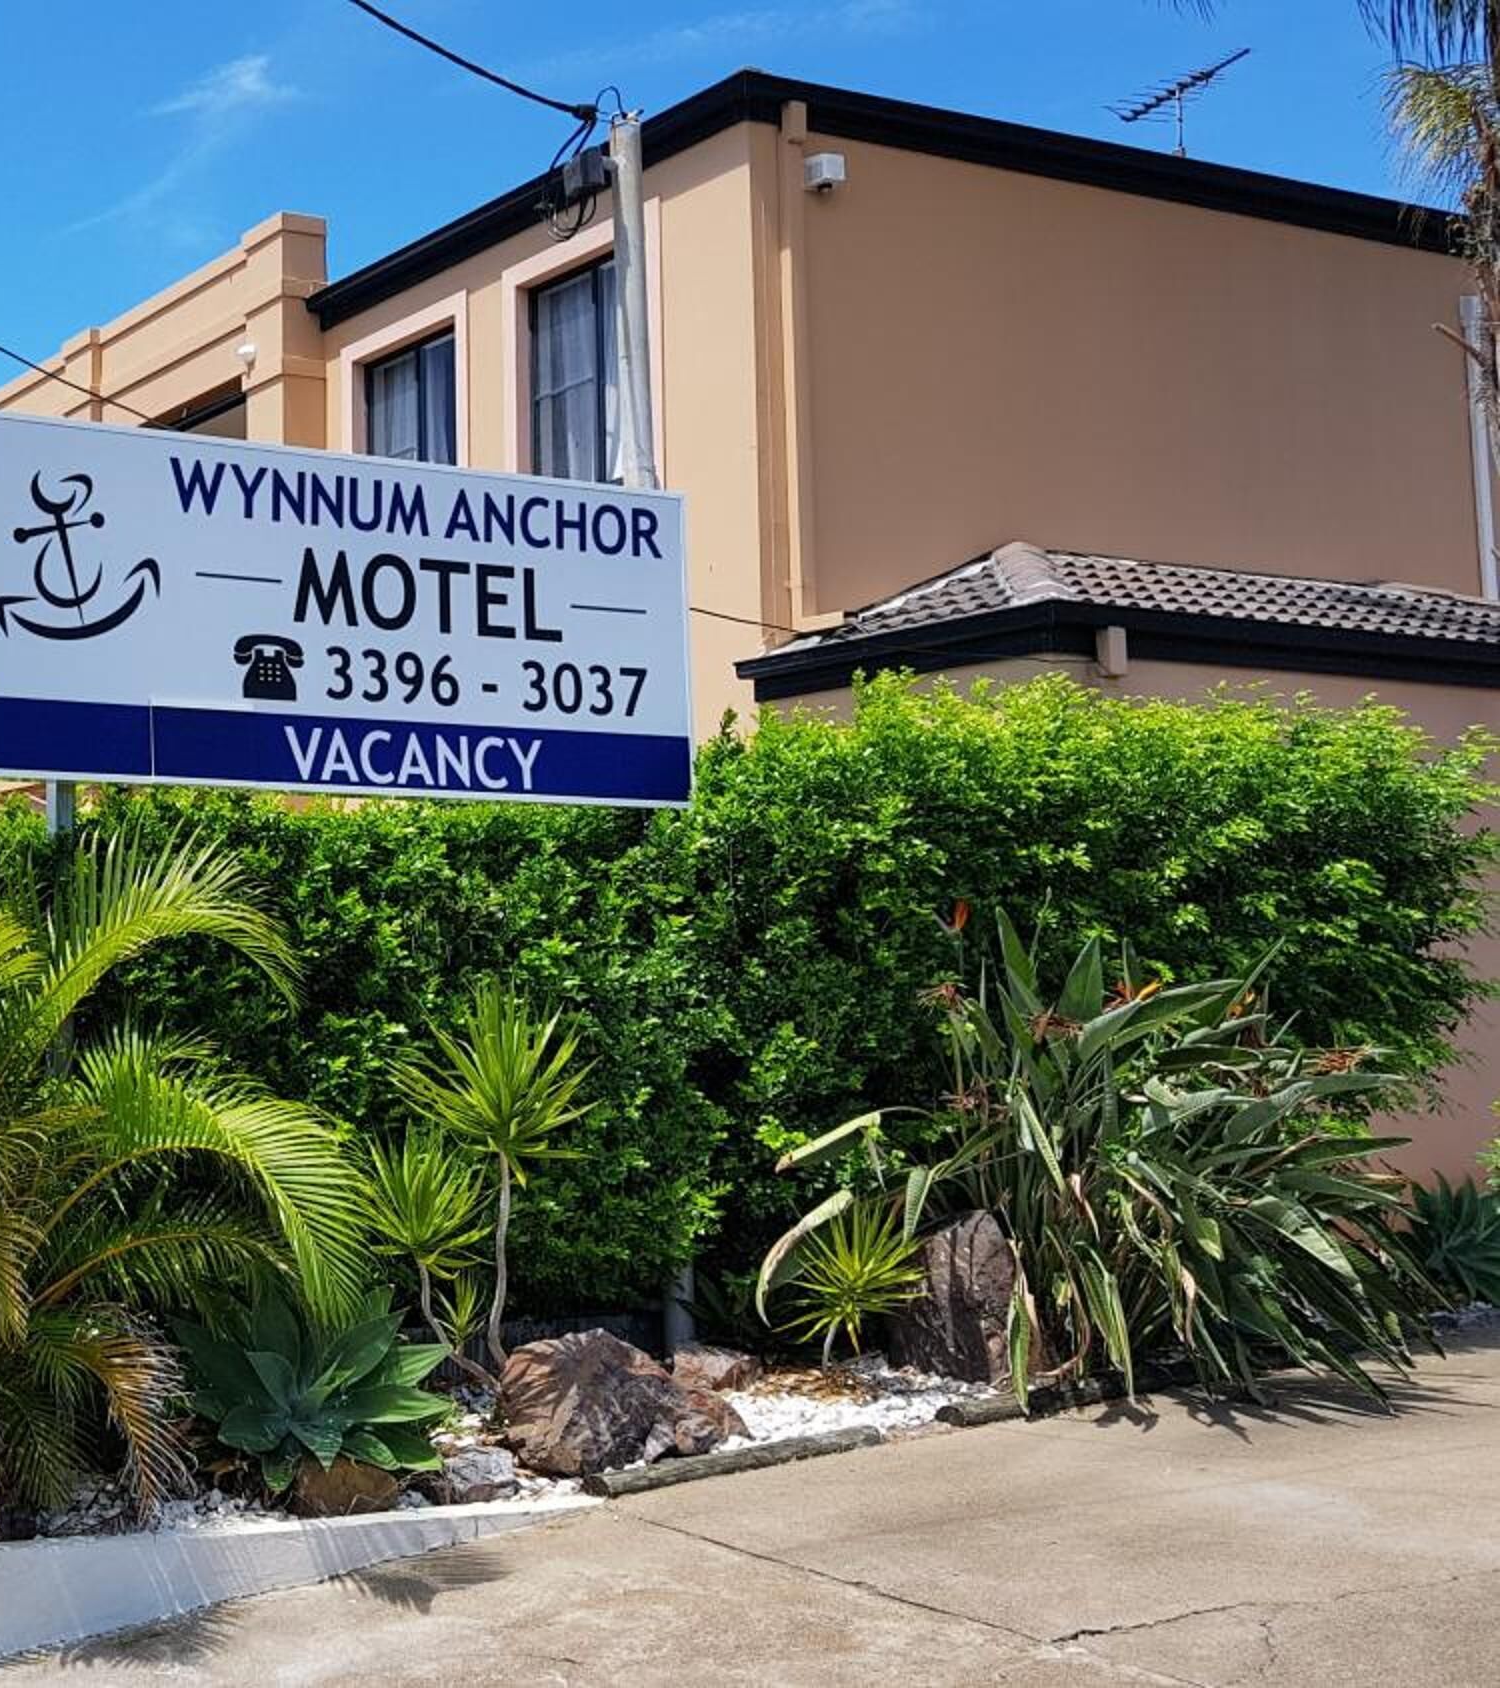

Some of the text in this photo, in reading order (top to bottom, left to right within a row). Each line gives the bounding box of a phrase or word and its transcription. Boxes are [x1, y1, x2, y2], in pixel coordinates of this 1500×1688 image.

[169, 455, 664, 560] WYNNUM ANCHOR
[293, 546, 564, 644] MOTEL
[325, 645, 461, 708] 3396
[521, 659, 649, 718] 3037
[283, 725, 543, 791] VACANCY
